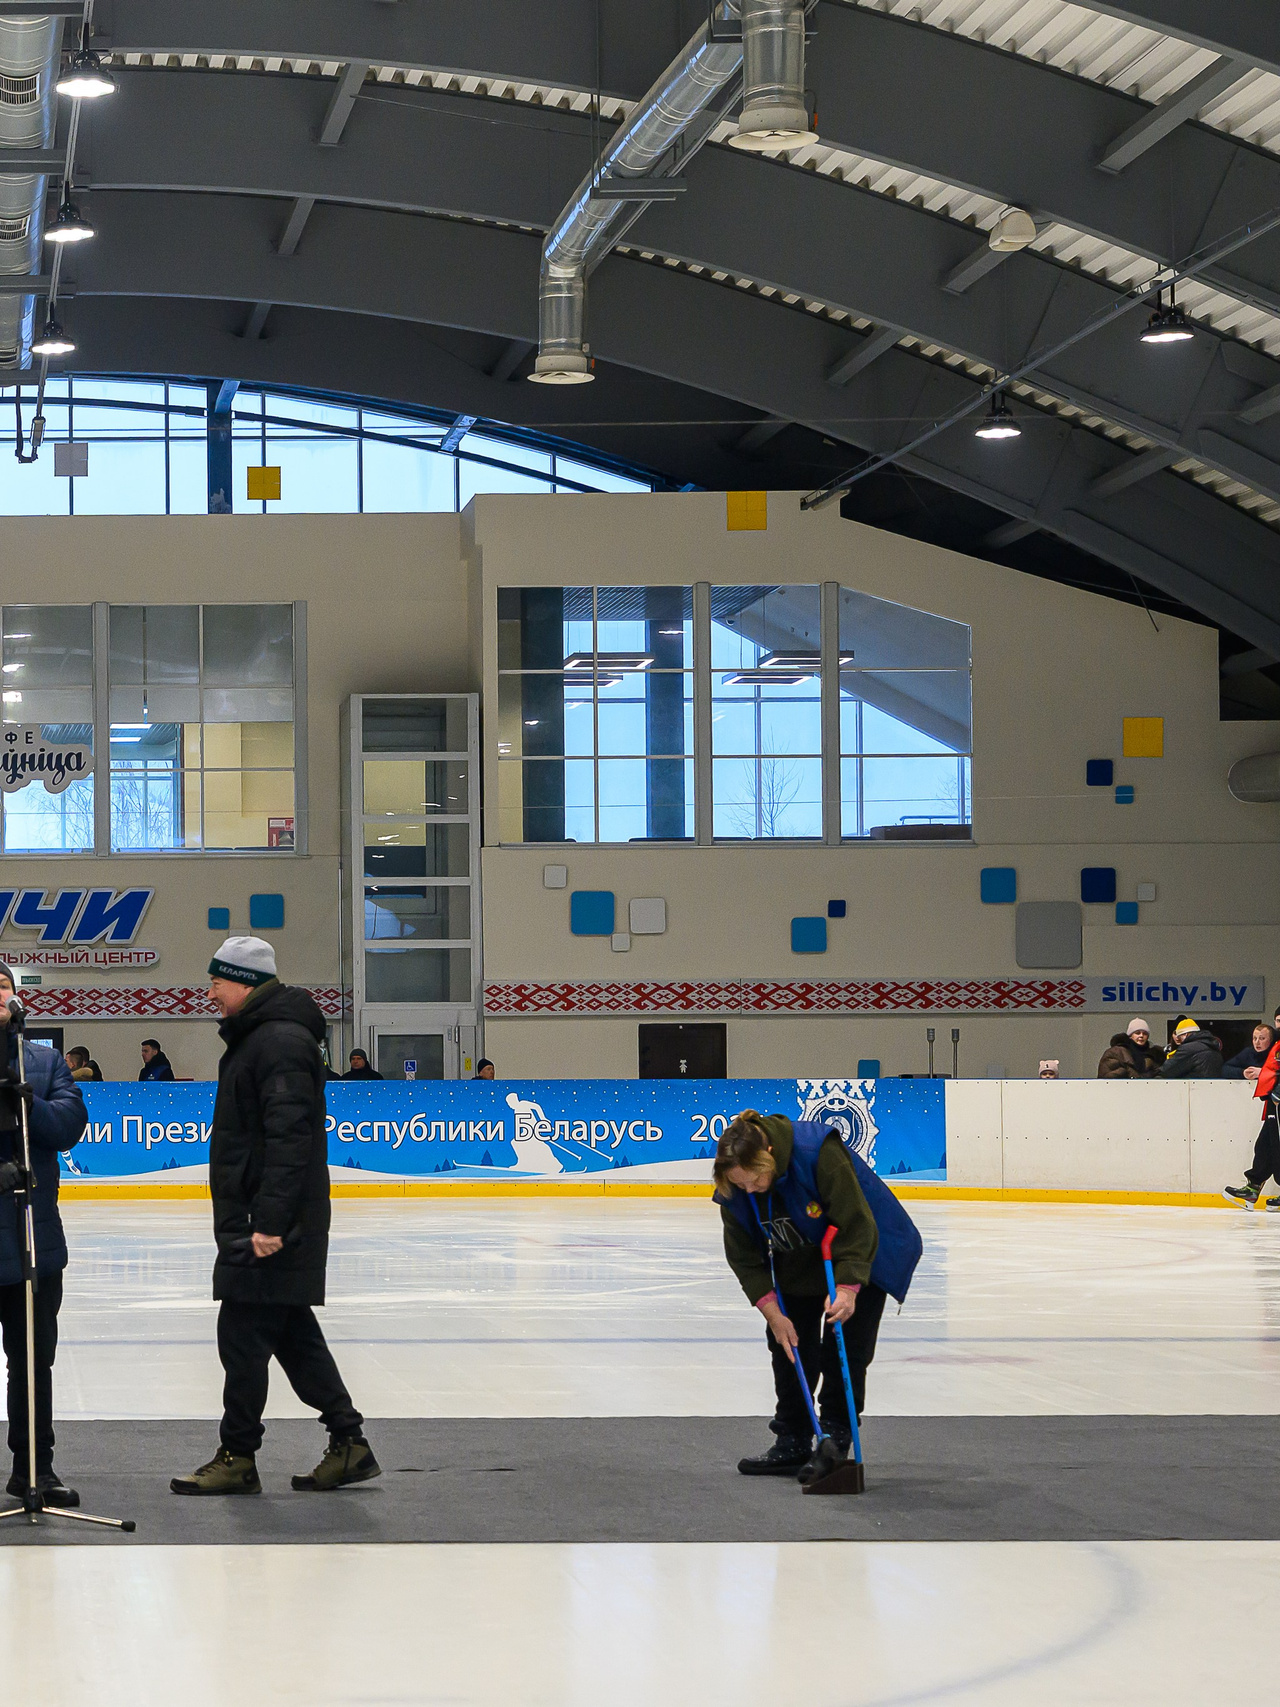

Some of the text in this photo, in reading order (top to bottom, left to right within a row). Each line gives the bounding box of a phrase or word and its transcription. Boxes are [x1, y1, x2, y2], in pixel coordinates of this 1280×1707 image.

[94, 951, 156, 965] ЦЕНТР
[1101, 981, 1248, 1006] silichy.by
[514, 1112, 664, 1150] Беларусь
[690, 1114, 740, 1142] 20
